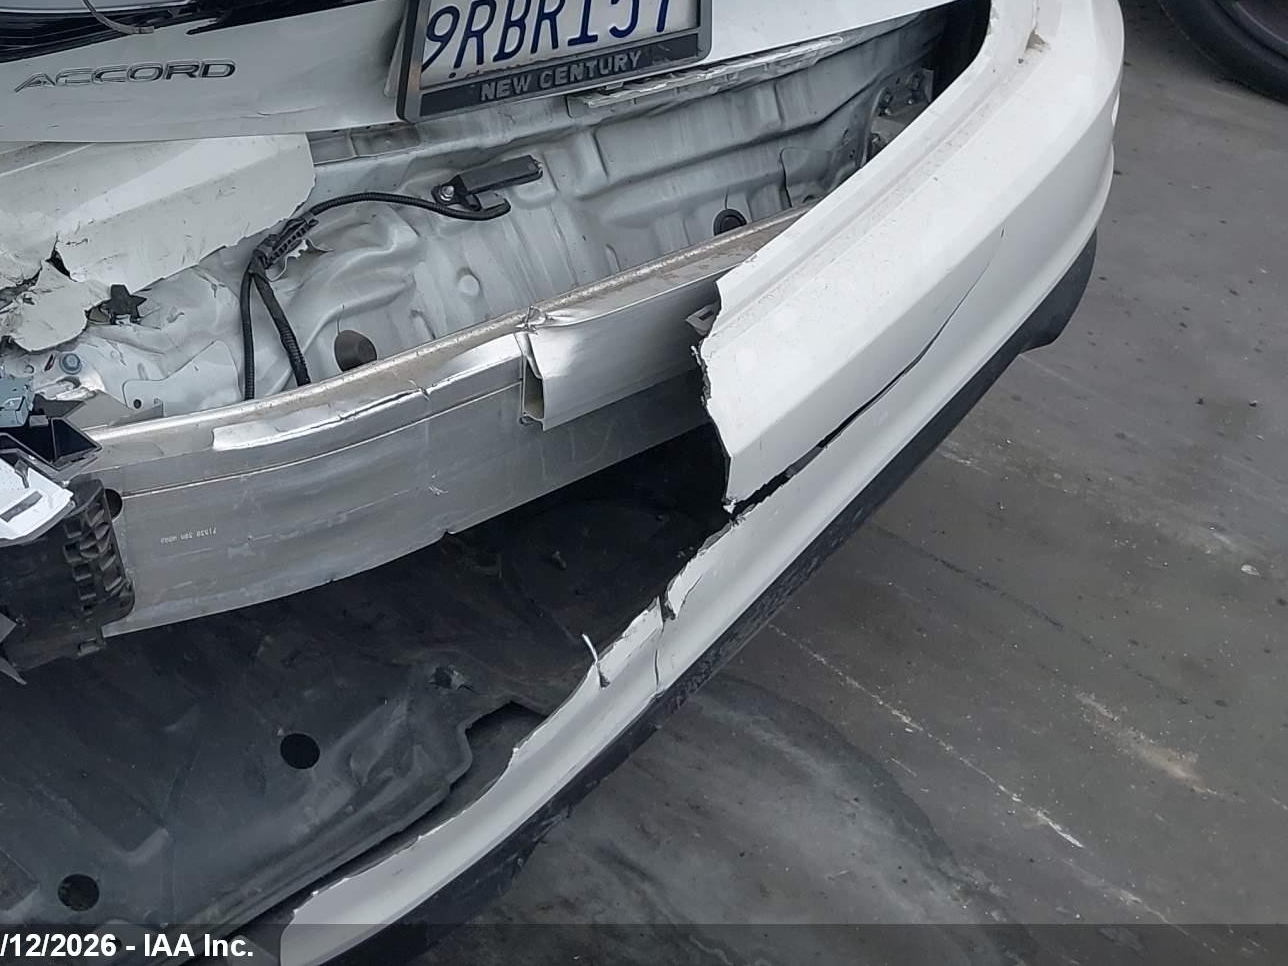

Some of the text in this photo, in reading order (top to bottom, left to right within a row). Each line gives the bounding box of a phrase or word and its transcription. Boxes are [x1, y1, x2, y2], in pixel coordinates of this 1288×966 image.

[14, 59, 236, 93] ACCORD
[480, 72, 532, 102] NEW
[539, 48, 642, 86] CENTURY
